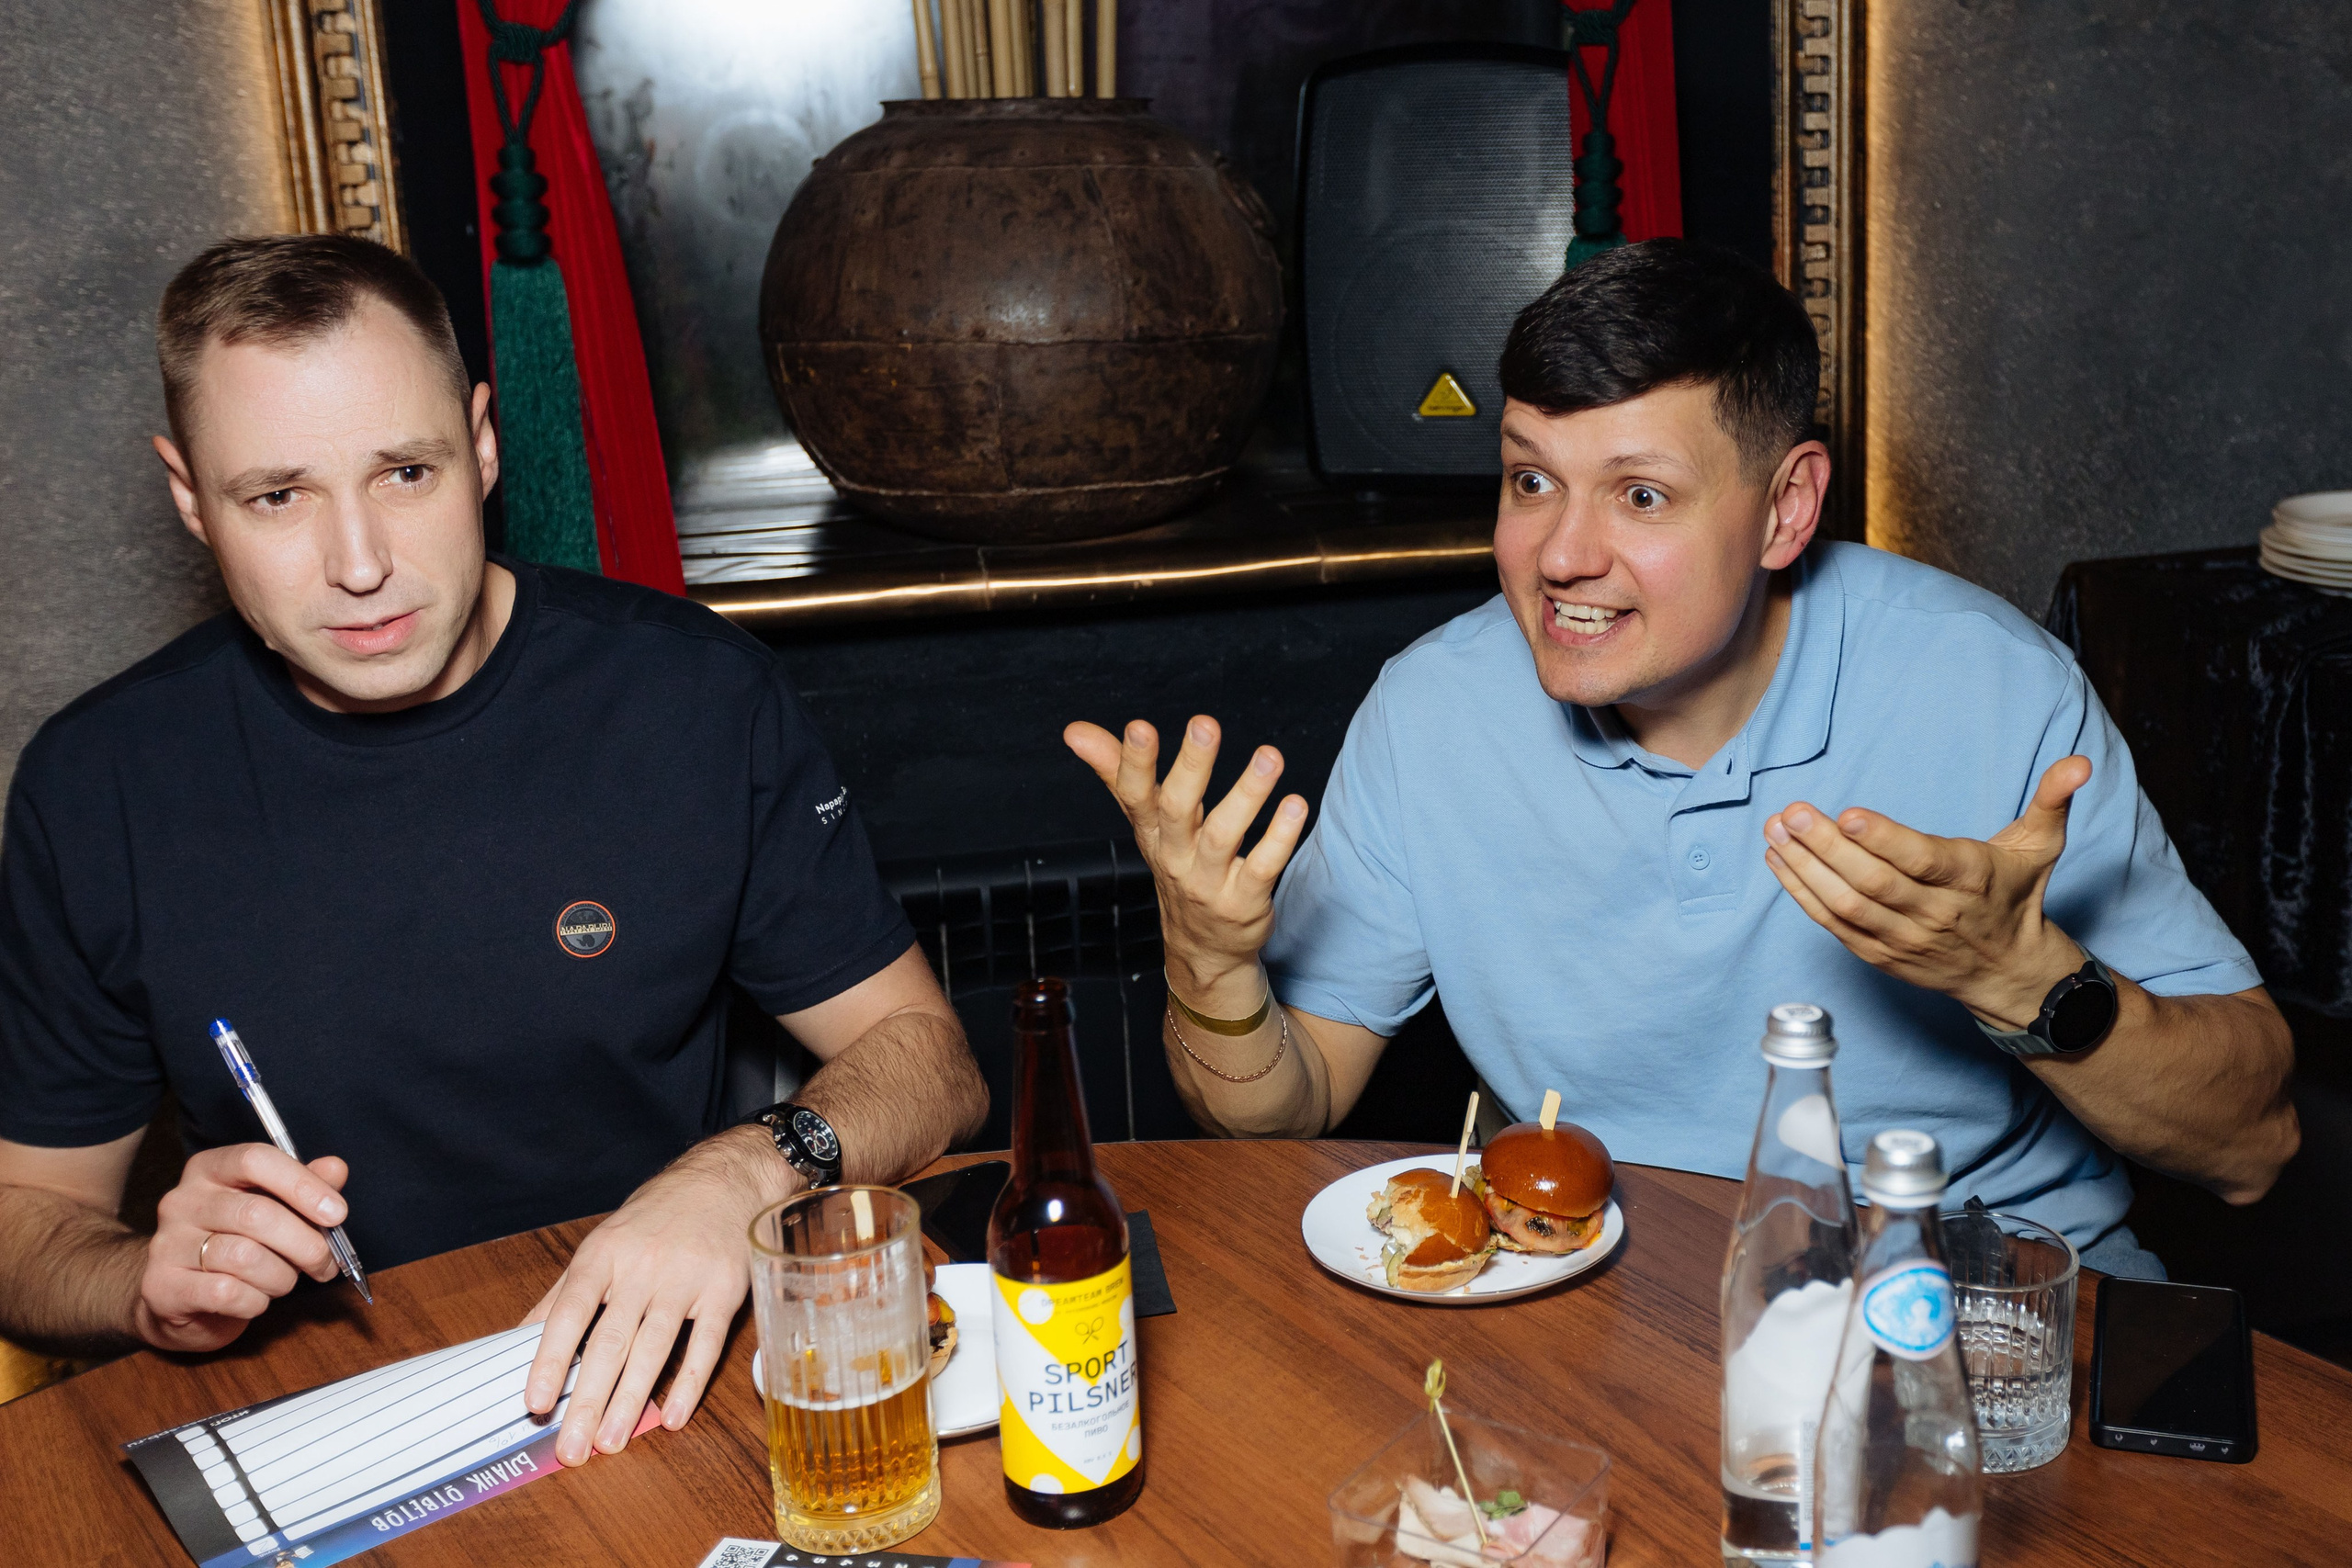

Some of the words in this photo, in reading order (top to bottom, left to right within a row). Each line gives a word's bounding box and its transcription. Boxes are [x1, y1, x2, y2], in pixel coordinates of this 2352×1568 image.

[1044, 1338, 1128, 1385] SPORT
[1029, 1360, 1137, 1414] PILSNER
[1051, 1399, 1130, 1431] БЕЗАЛКОГОЛЬНОЕ
[1084, 1424, 1109, 1438] ПИВО
[465, 1450, 538, 1494] БЛАНК
[370, 1484, 465, 1532] ОТВЕТОВ
